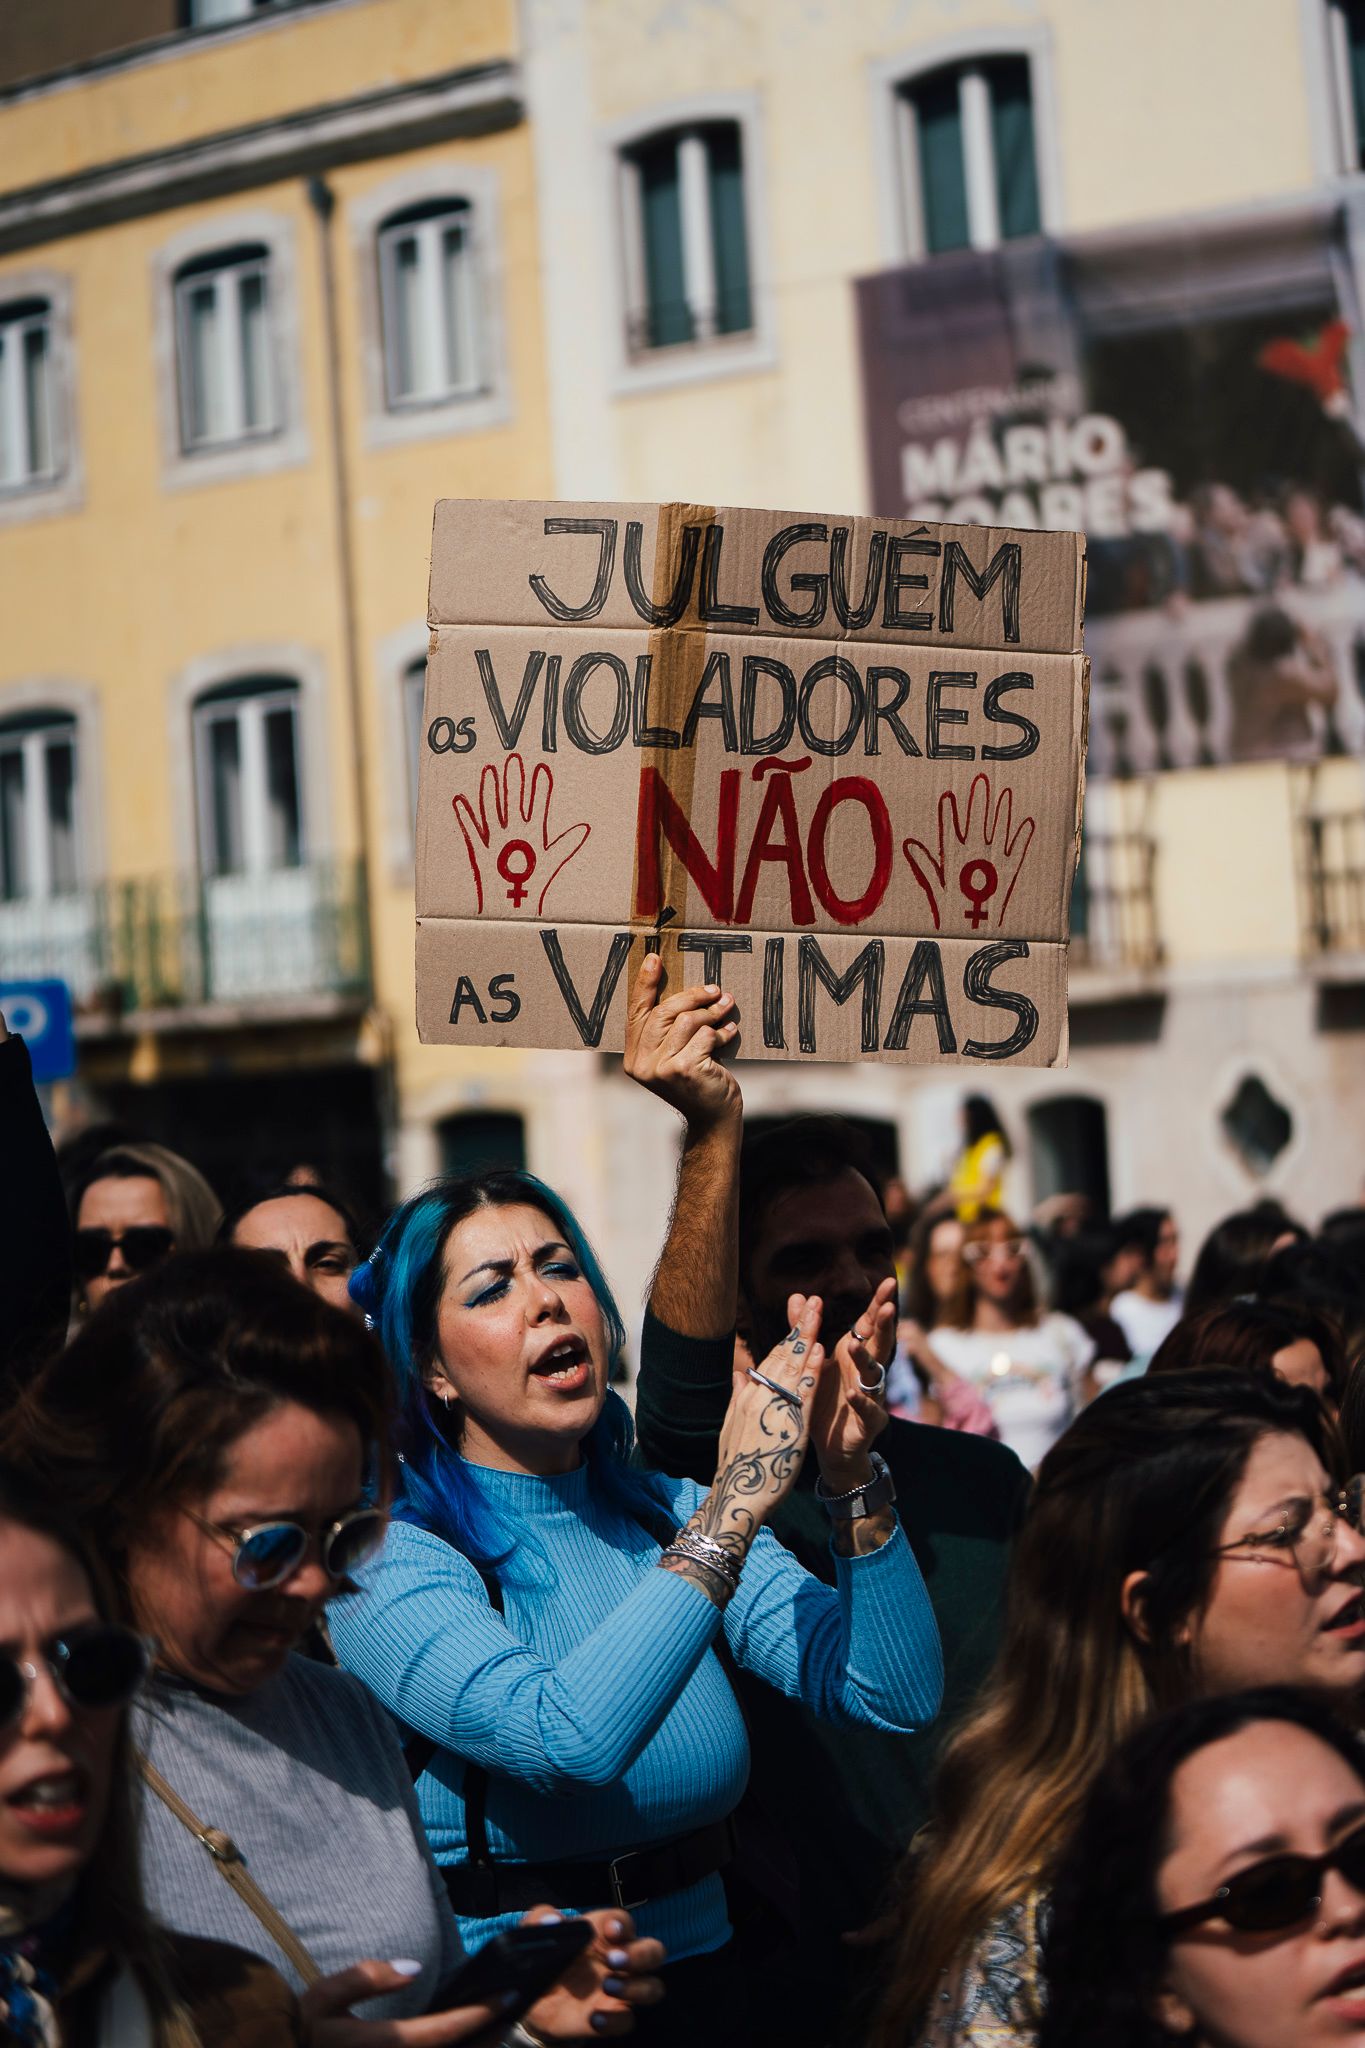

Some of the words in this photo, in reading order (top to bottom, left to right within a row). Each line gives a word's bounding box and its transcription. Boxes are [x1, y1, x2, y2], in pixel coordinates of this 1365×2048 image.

[529, 518, 1021, 643] JULGUÉM
[475, 649, 1040, 760] VIOLADORES
[635, 756, 894, 925] NÃO
[449, 973, 521, 1024] AS
